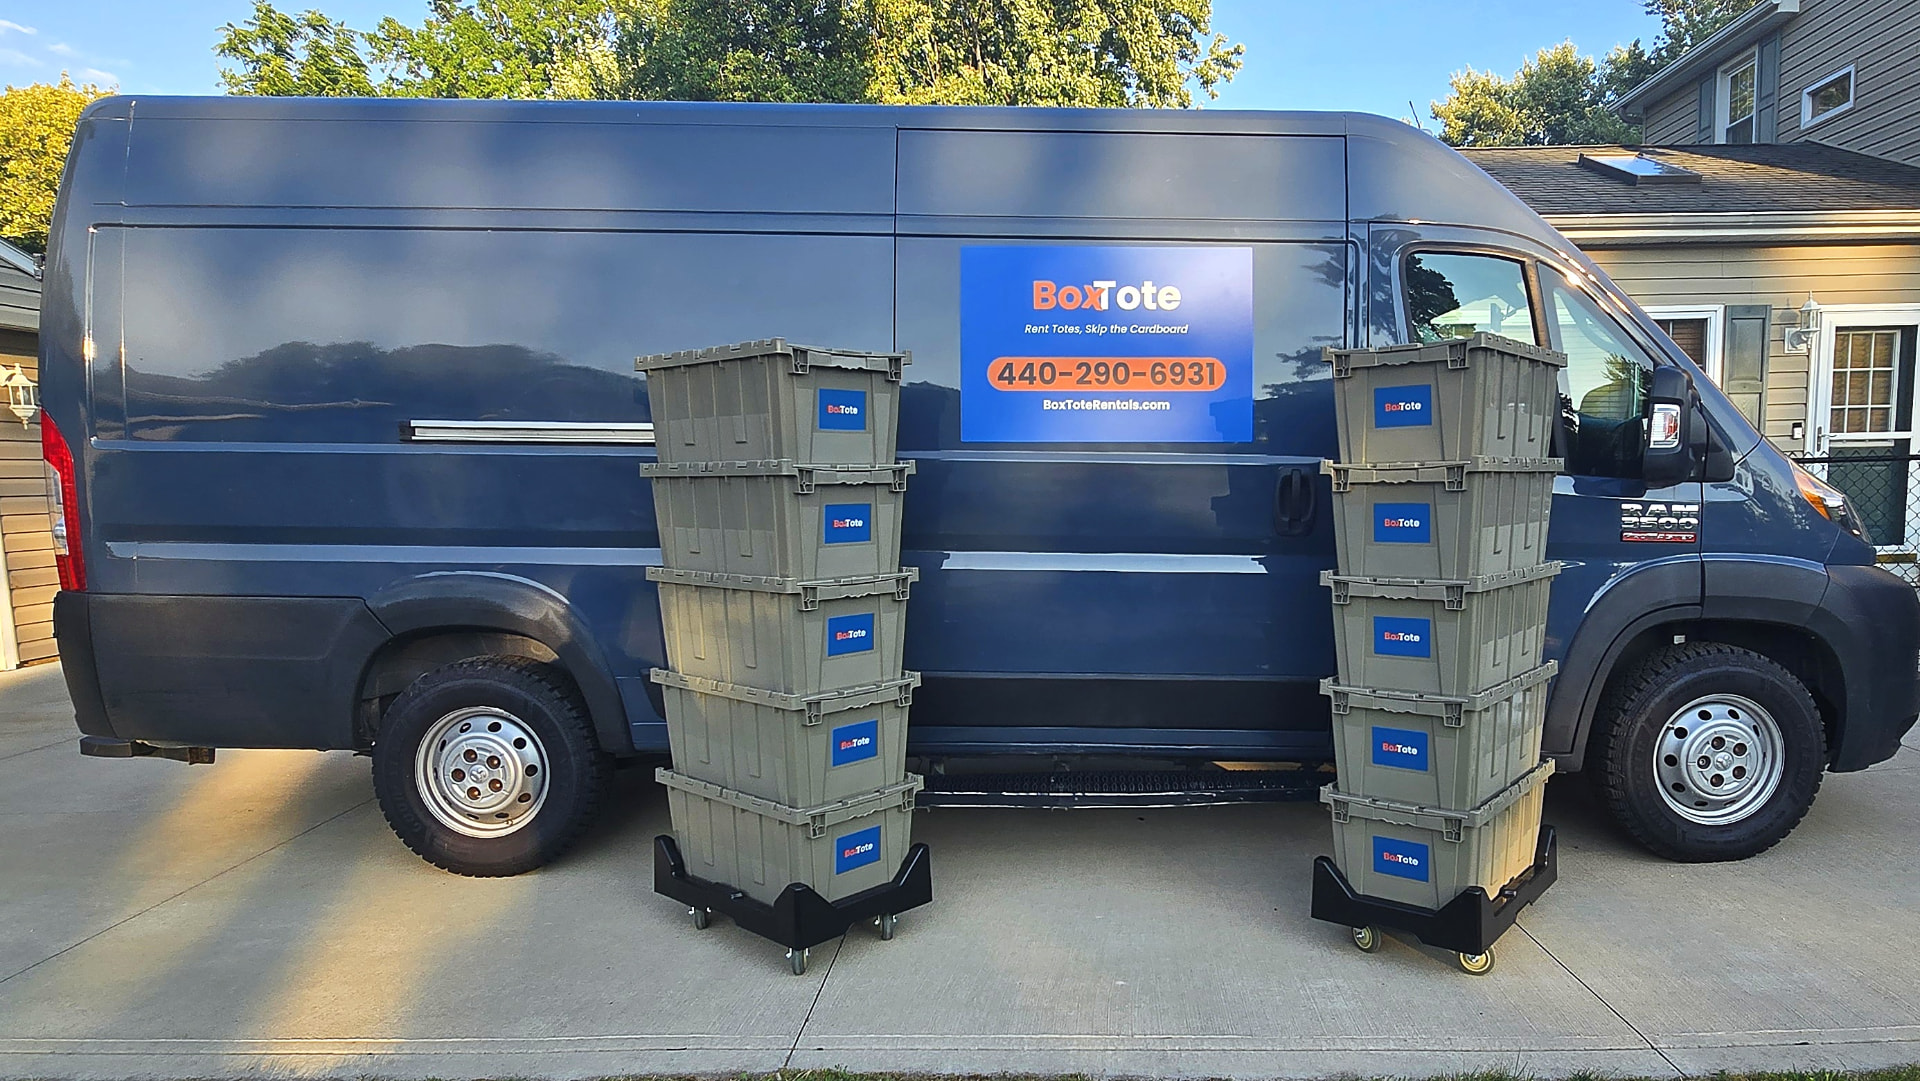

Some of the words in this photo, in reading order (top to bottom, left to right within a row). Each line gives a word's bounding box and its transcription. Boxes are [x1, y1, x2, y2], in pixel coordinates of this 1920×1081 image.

[1033, 280, 1182, 311] BoxTote
[1025, 324, 1049, 334] Rent
[1052, 324, 1083, 336] Totes,
[1085, 324, 1107, 336] Skip
[1110, 324, 1128, 334] the
[1130, 324, 1189, 334] Cardboard
[998, 362, 1216, 385] 440-290-6931
[1043, 399, 1171, 411] BoxToteRentals.com
[1621, 503, 1699, 517] RAM
